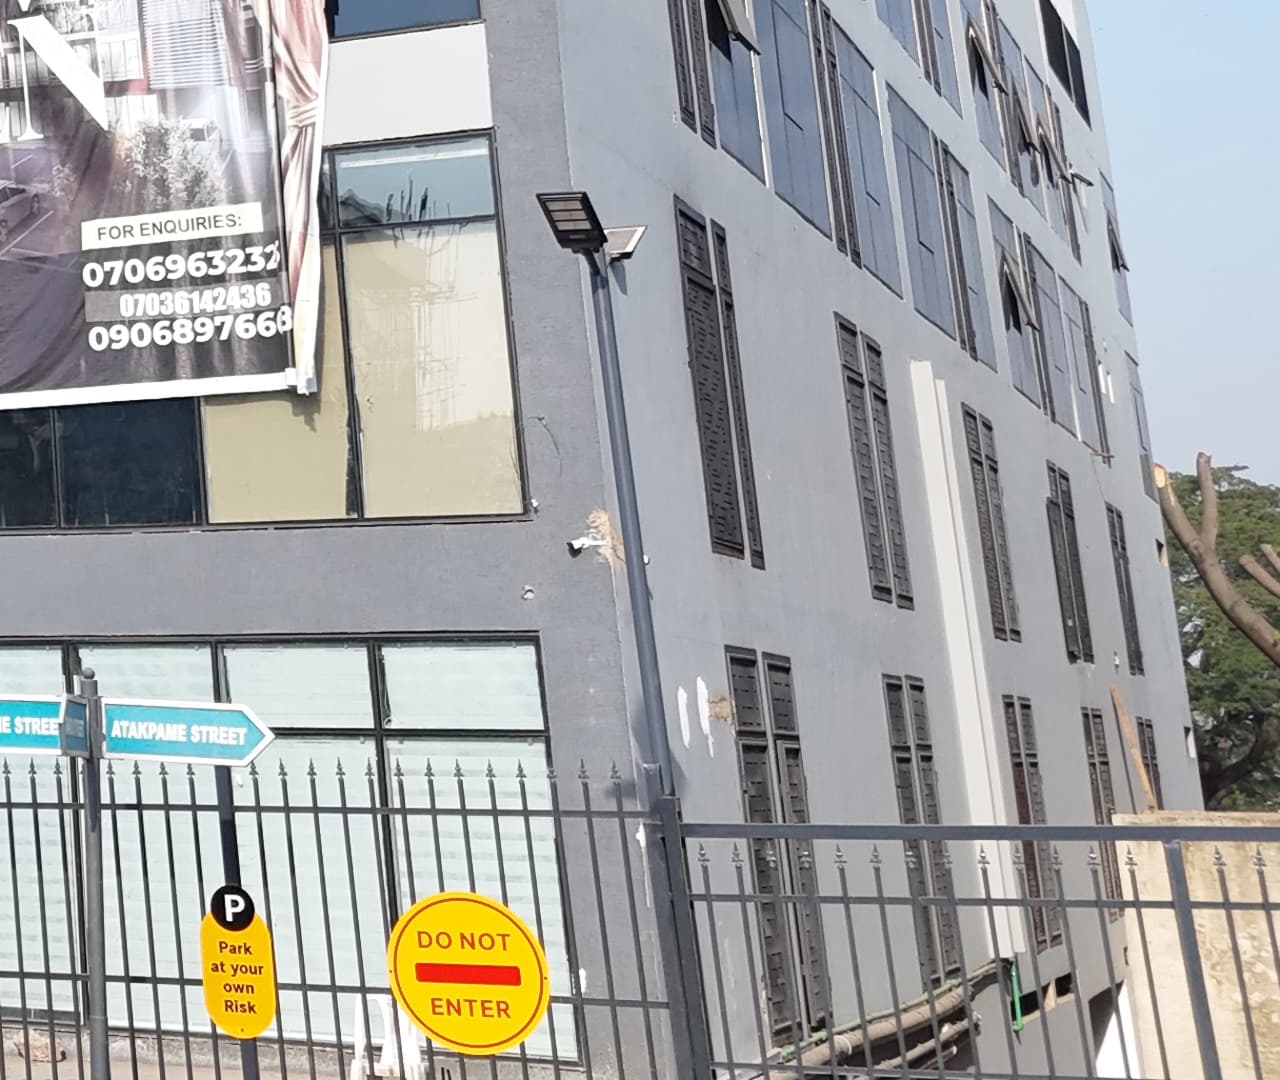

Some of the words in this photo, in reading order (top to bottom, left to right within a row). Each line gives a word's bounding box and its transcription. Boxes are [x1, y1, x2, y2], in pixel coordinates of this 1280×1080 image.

[97, 224, 135, 241] FOR
[139, 213, 243, 238] ENQUIRIES:
[119, 282, 272, 318] 07036142436
[14, 716, 59, 736] STREE
[110, 719, 188, 742] ATAKPAME
[191, 725, 248, 746] STREET
[223, 893, 246, 923] P
[218, 940, 253, 956] Park
[416, 930, 453, 950] DO
[459, 931, 511, 952] NOT
[210, 960, 226, 973] at
[230, 963, 264, 977] your
[222, 982, 255, 995] own
[224, 999, 257, 1015] Risk
[430, 997, 512, 1019] ENTER
